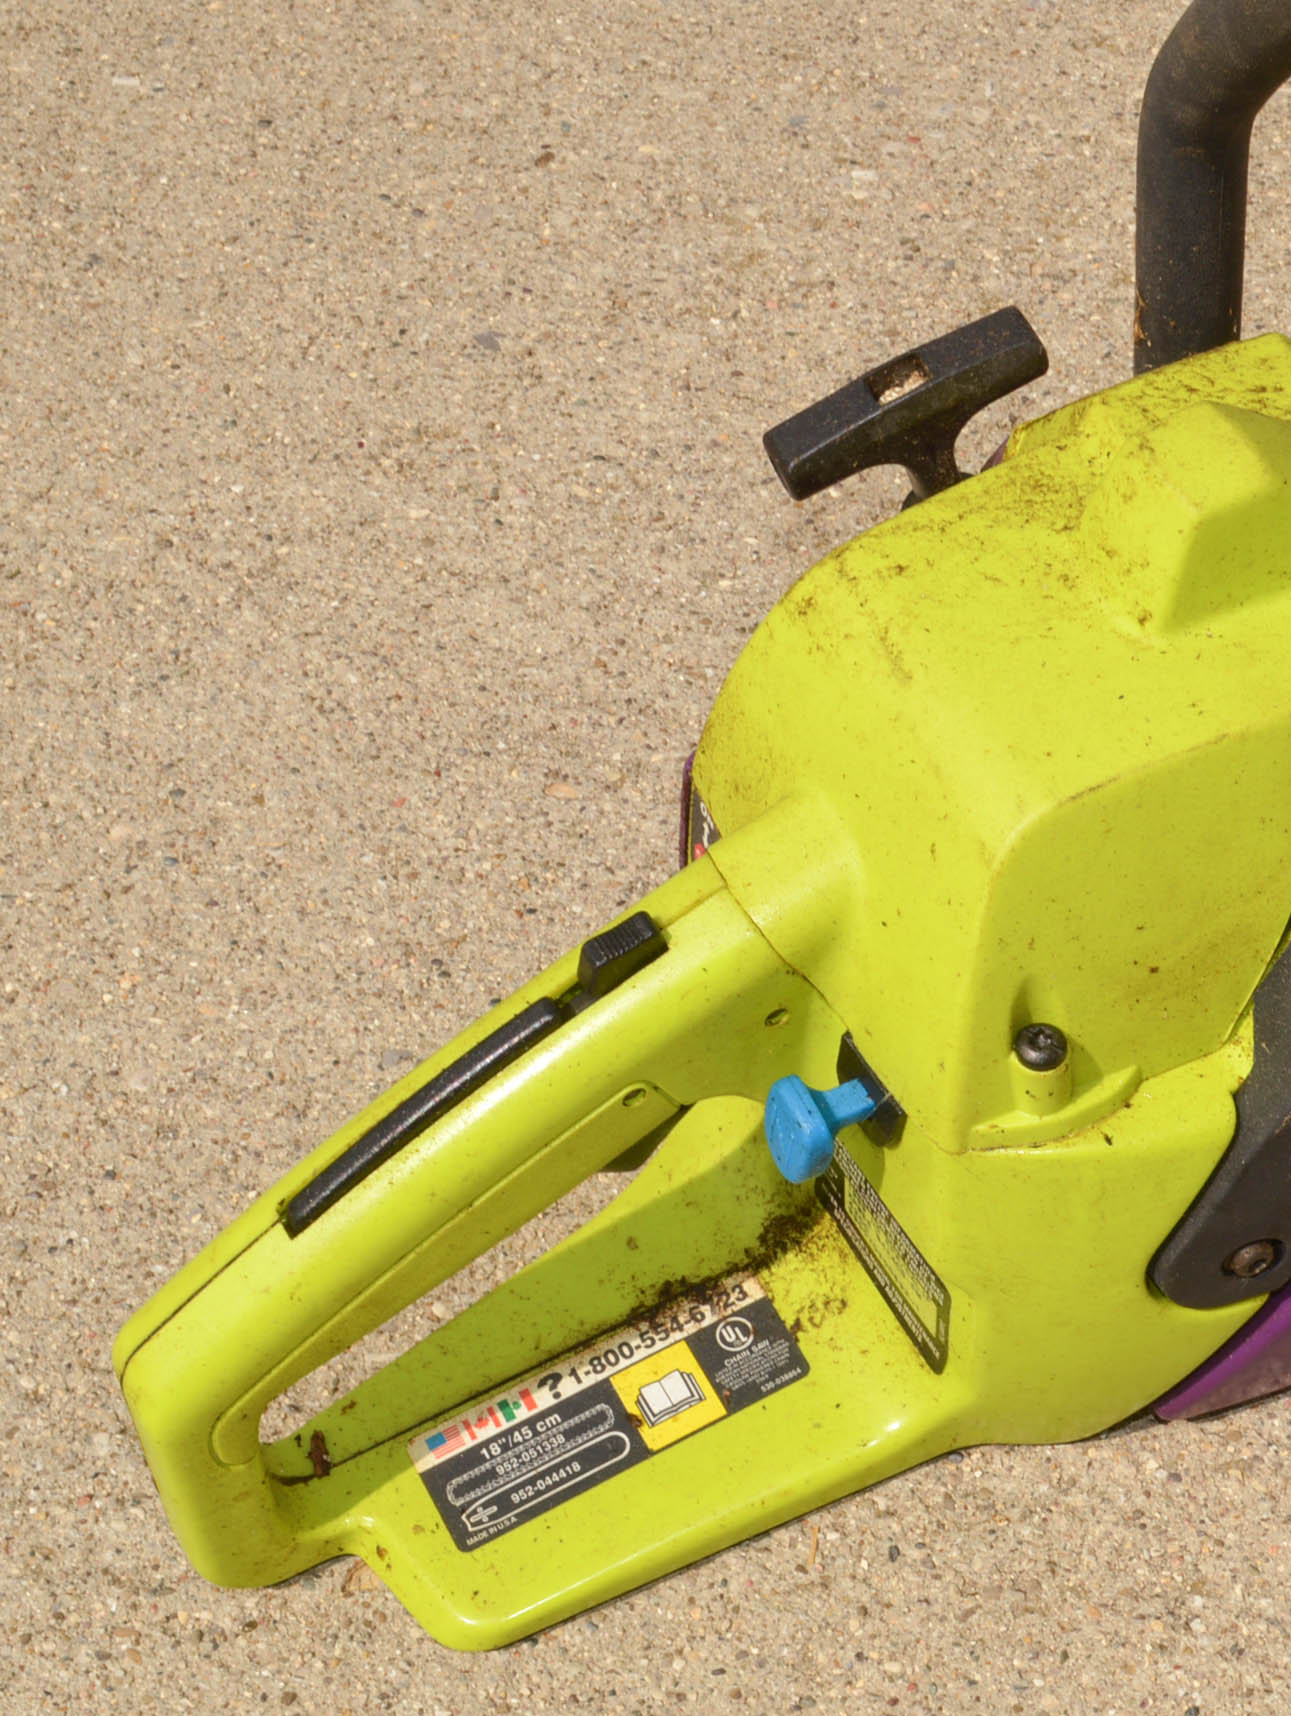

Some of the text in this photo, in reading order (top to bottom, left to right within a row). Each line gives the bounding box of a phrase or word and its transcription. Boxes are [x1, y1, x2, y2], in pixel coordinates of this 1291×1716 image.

[534, 1410, 562, 1432] cm
[495, 1432, 566, 1477] 952-051338
[510, 1460, 582, 1505] 952-044418
